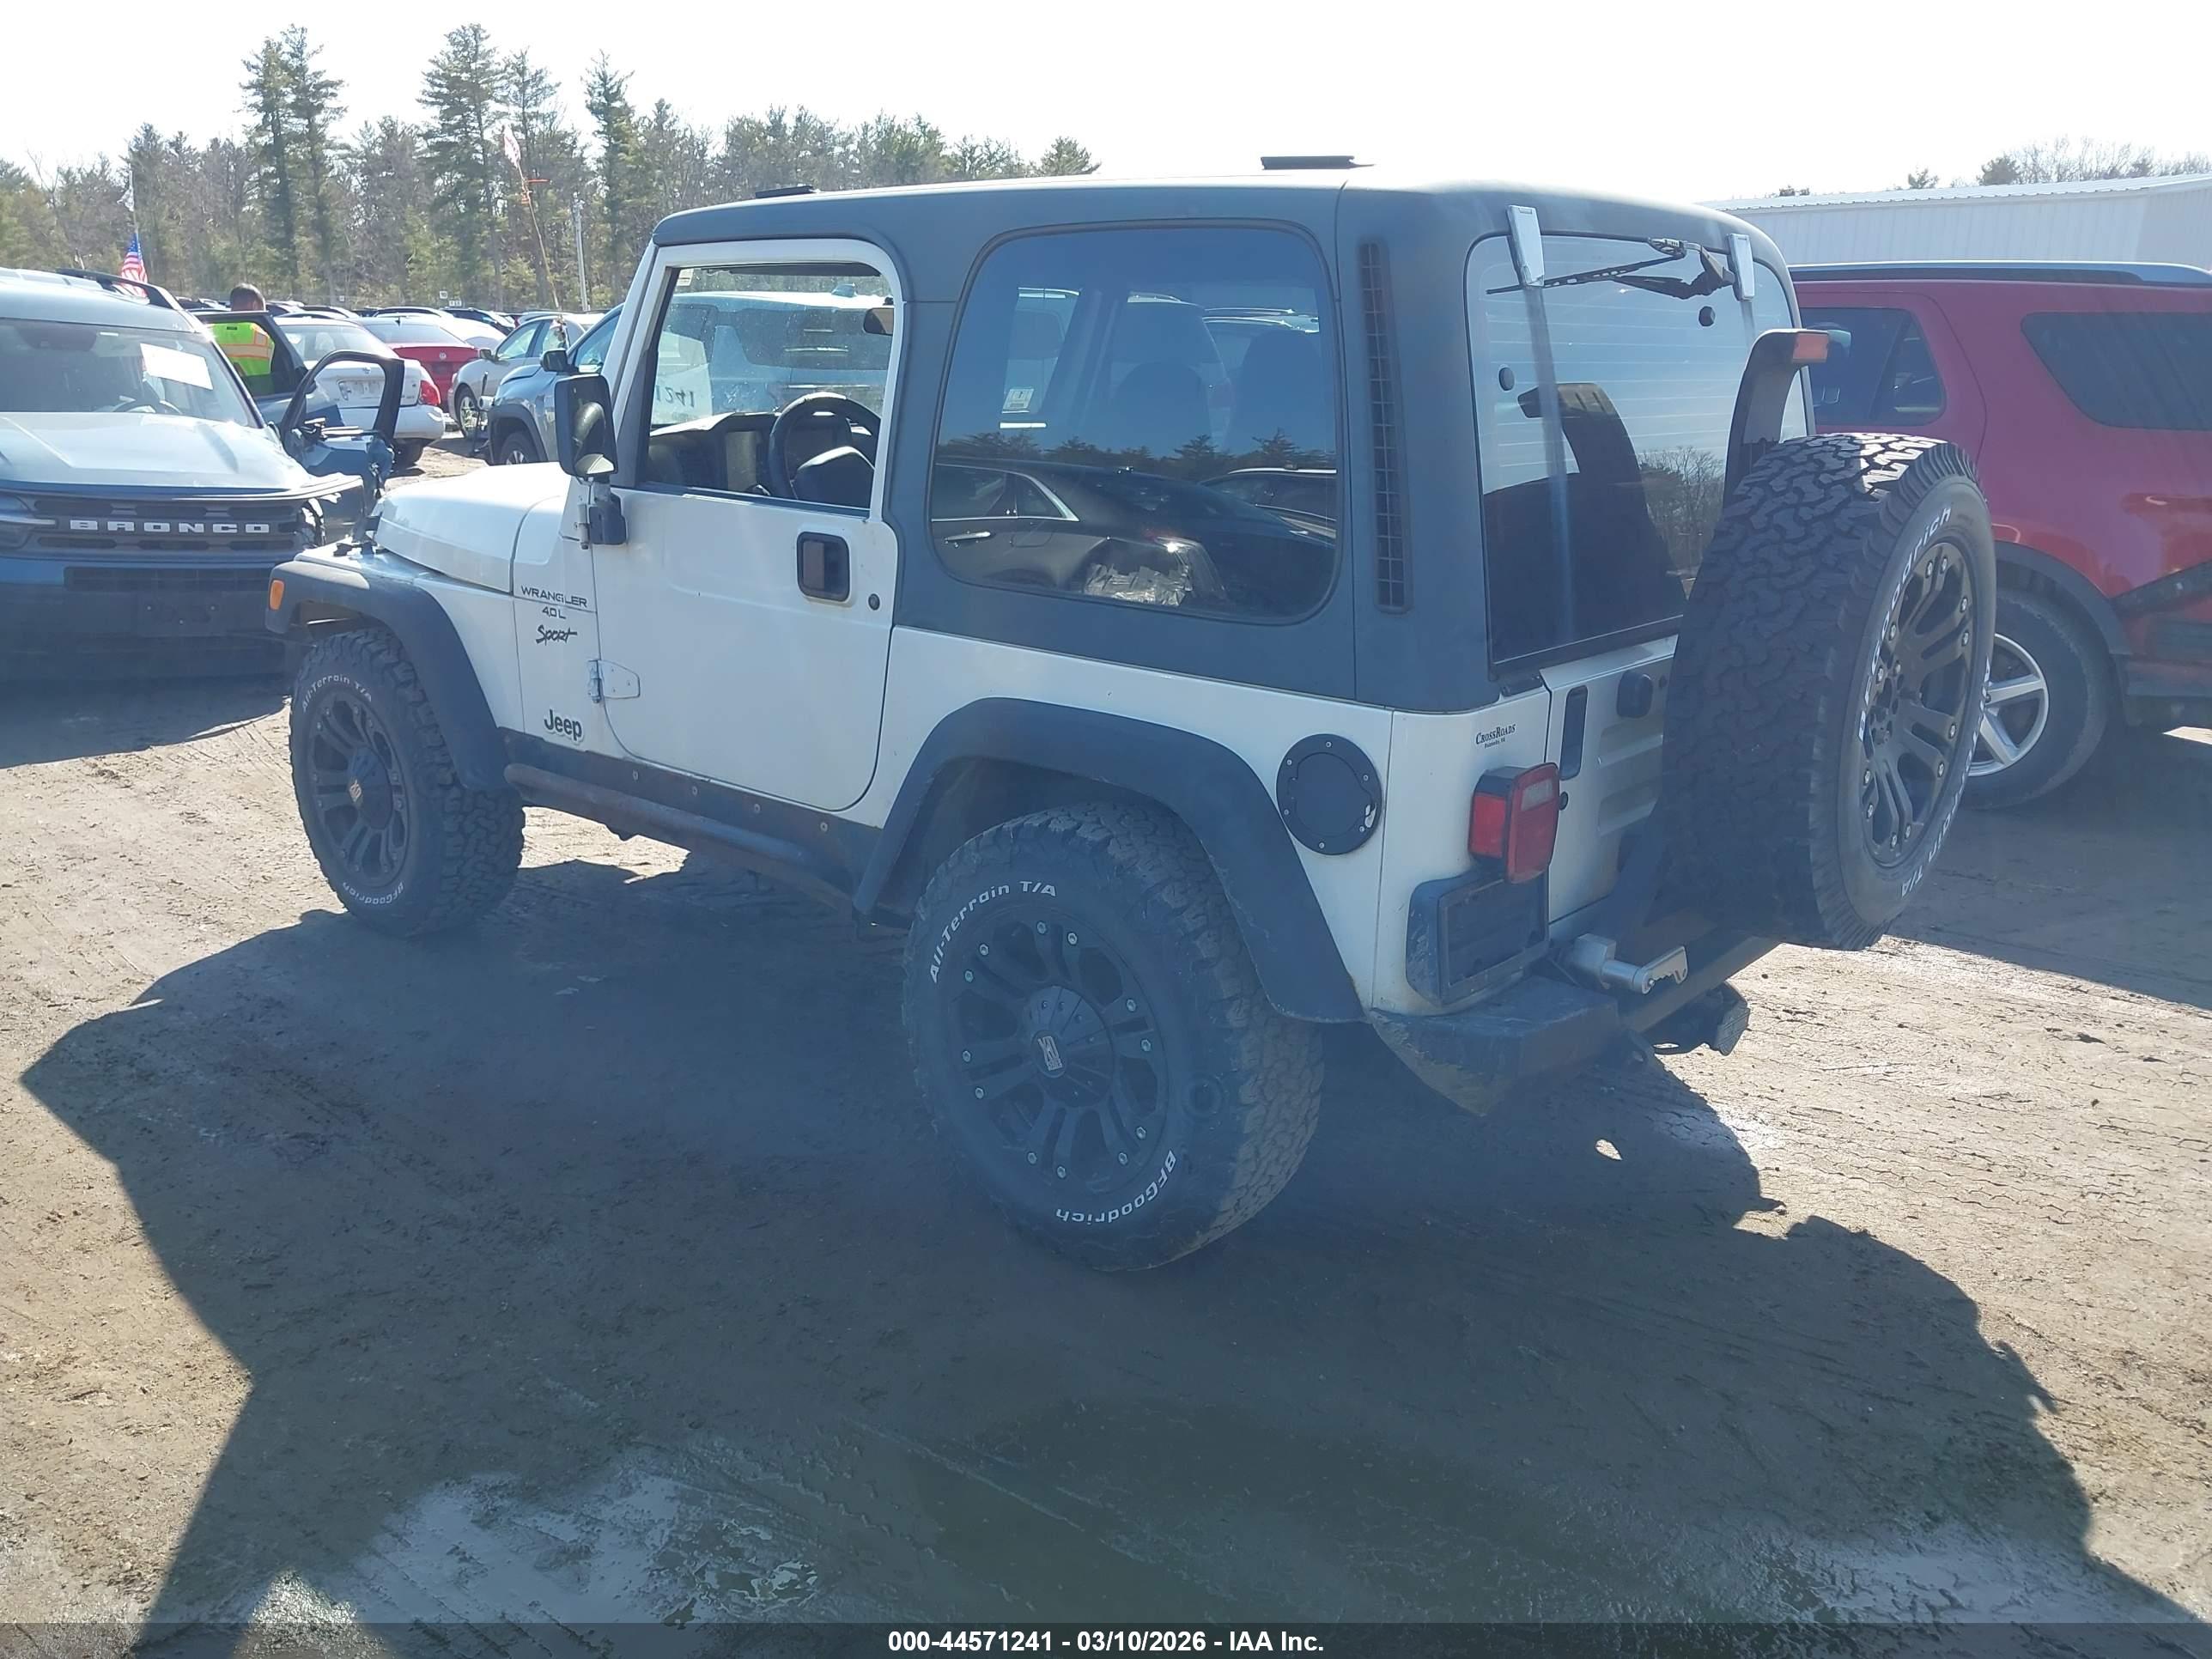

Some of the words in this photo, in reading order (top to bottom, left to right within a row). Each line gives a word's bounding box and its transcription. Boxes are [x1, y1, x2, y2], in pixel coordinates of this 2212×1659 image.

[70, 520, 270, 534] BRONCO
[520, 585, 588, 608] WRANGLER
[1857, 507, 1952, 743] BFGoodrich
[544, 708, 583, 741] Jeep
[929, 883, 1011, 984] All-Terrain
[1019, 880, 1057, 898] T/A
[1055, 1149, 1177, 1225] BFGoodrich
